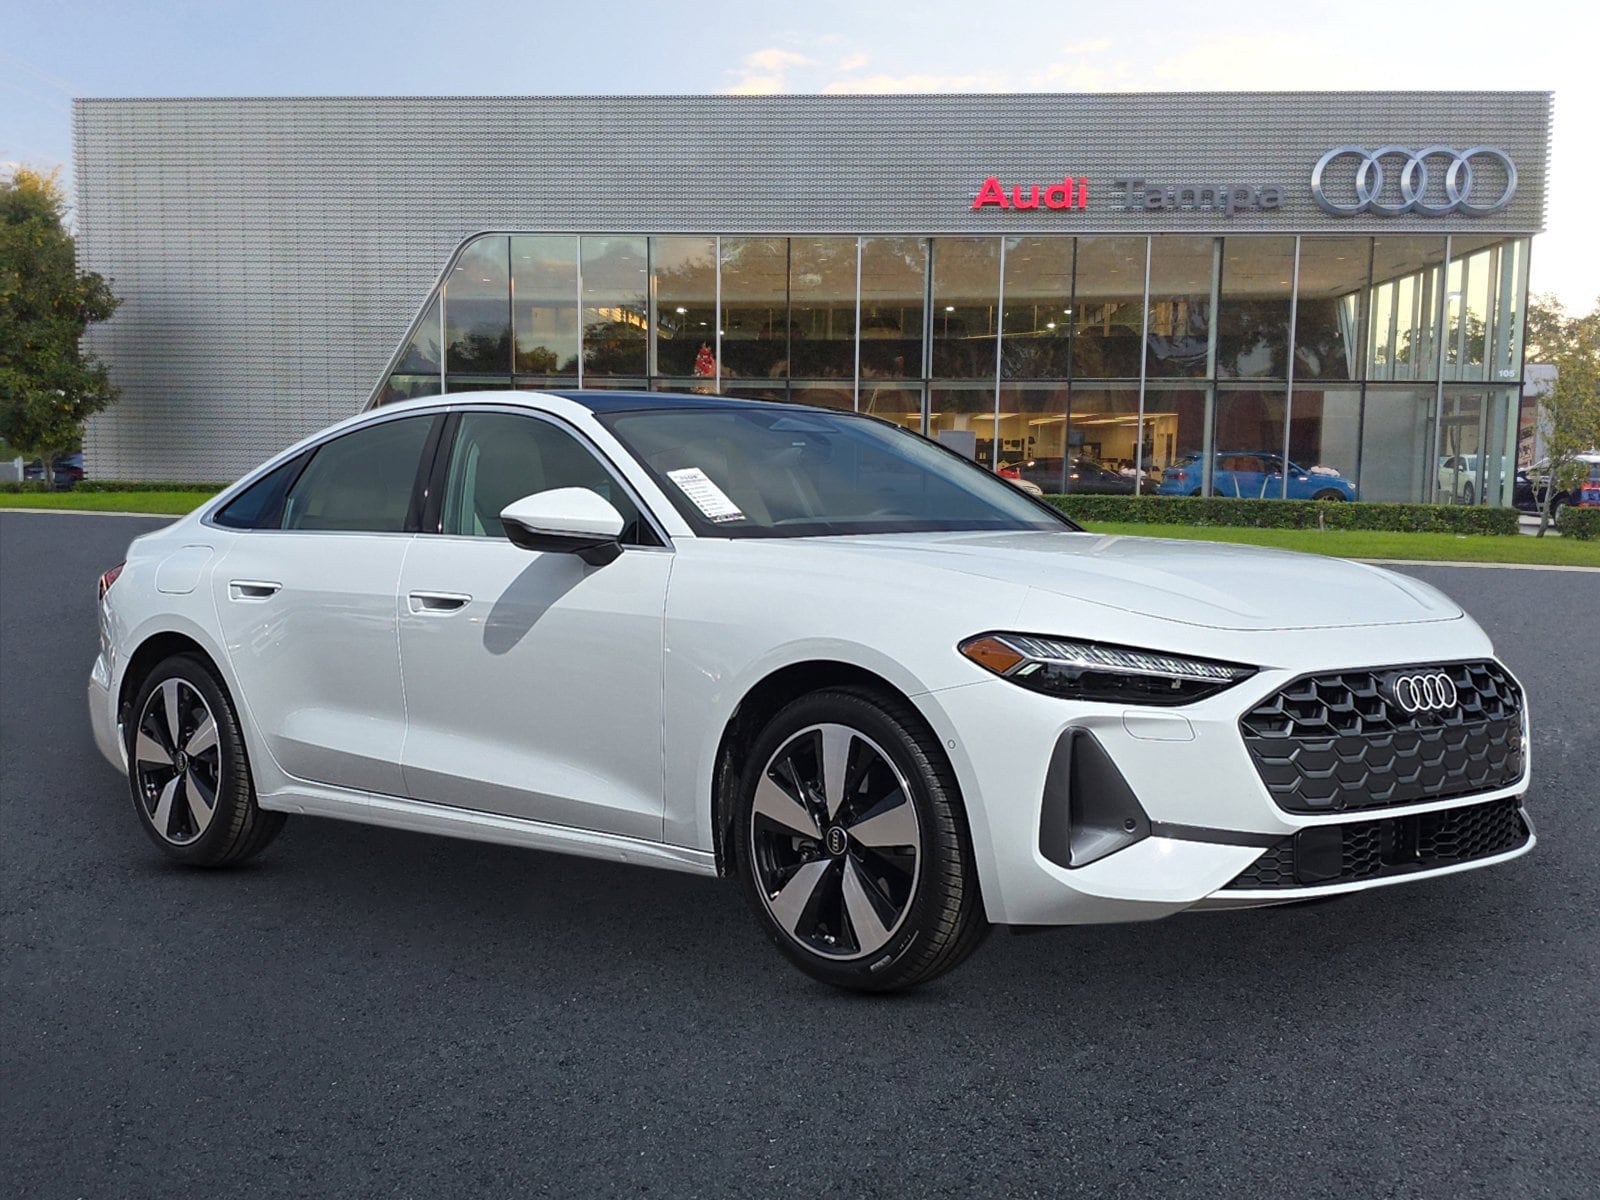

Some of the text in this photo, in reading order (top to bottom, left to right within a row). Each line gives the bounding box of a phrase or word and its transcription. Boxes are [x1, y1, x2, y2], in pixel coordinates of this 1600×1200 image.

[972, 176, 1284, 218] Audi Tampa
[1499, 369, 1515, 378] 105
